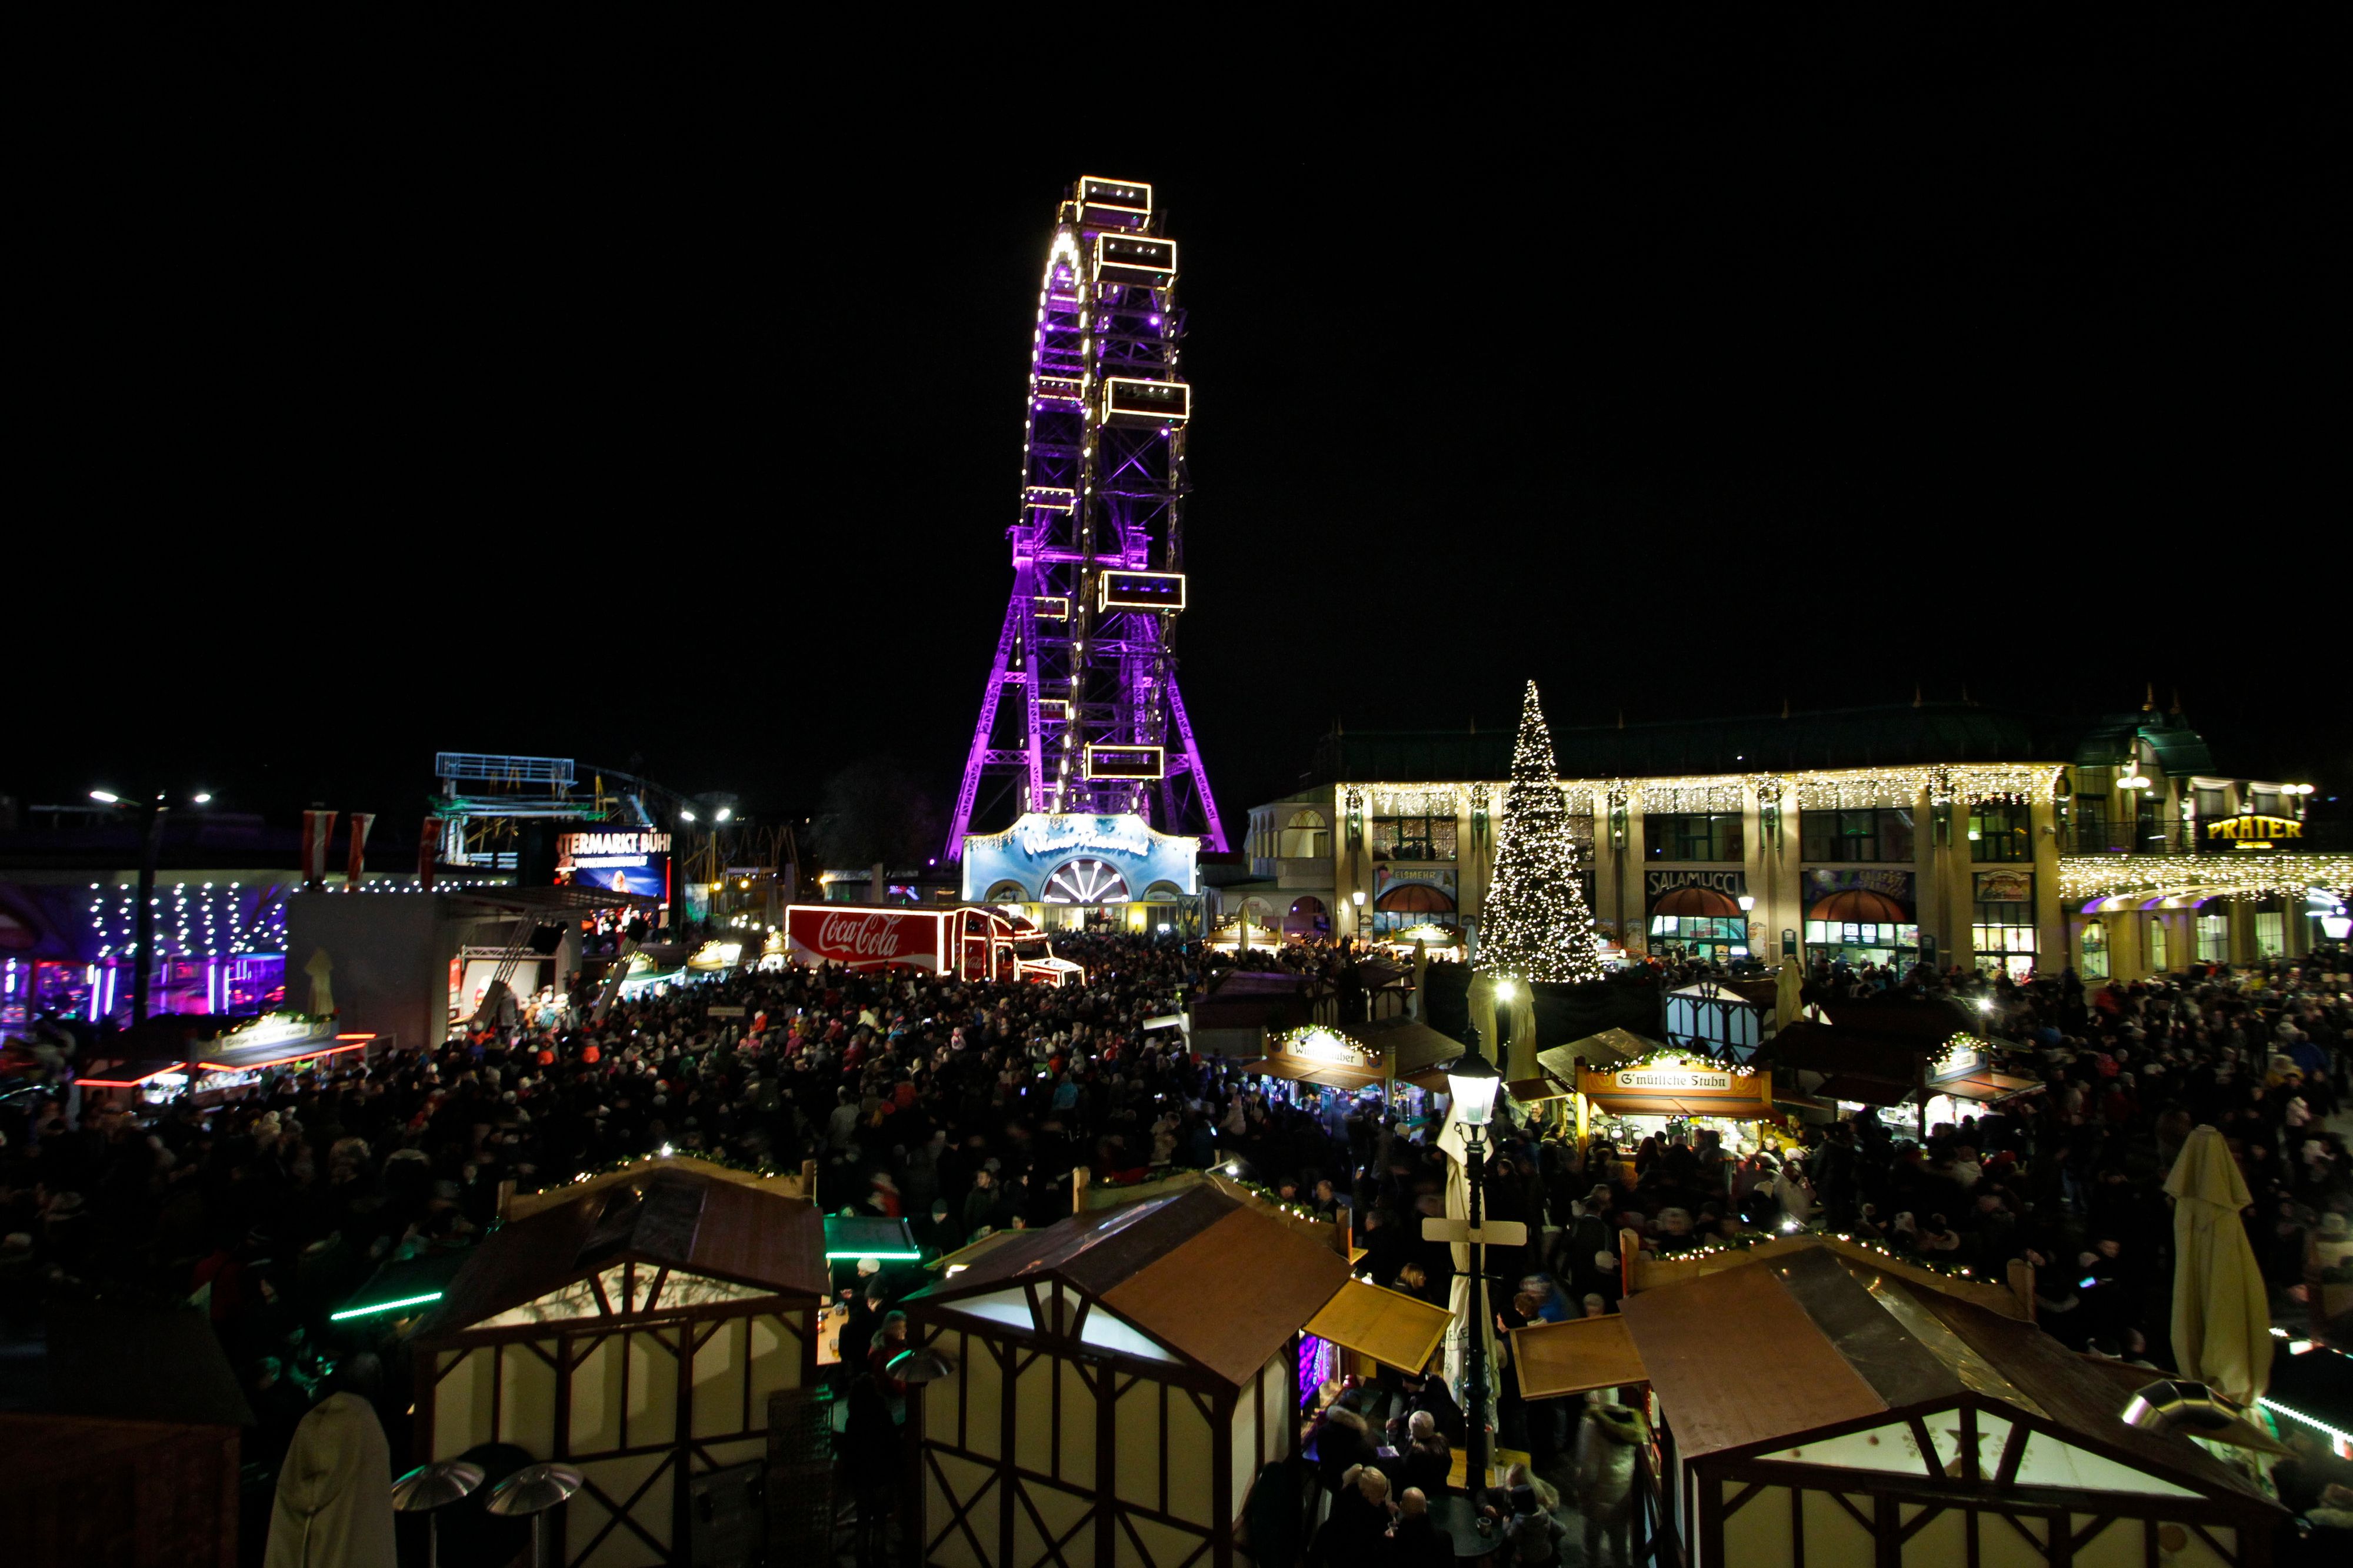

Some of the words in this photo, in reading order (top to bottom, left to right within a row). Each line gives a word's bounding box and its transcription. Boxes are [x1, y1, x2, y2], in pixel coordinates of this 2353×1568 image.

[2207, 816, 2303, 839] PRATER
[1648, 872, 1739, 895] SALAMUCCI
[818, 912, 904, 957] Coca-Cola
[1691, 1075, 1726, 1086] Stubn
